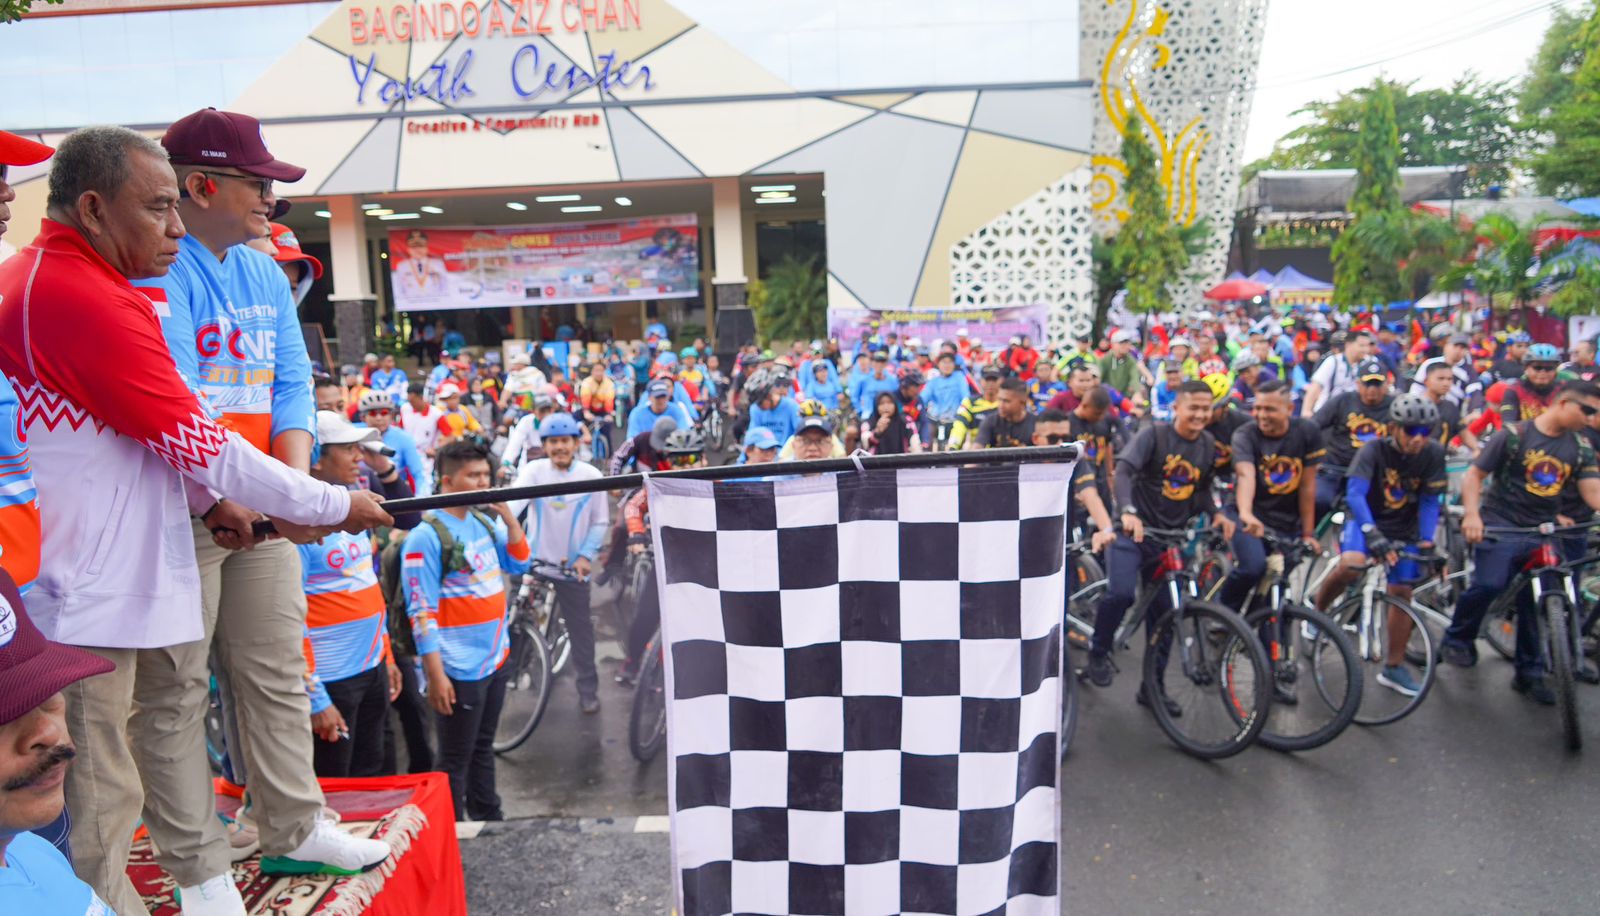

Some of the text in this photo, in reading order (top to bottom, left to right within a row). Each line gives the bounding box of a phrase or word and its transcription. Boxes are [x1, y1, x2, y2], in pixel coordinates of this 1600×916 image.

[350, 0, 641, 44] BAGINDO AZIZ CHAN
[349, 44, 656, 104] Youth Center
[407, 119, 467, 135] Creative
[486, 115, 568, 130] Community
[574, 113, 600, 127] Hub
